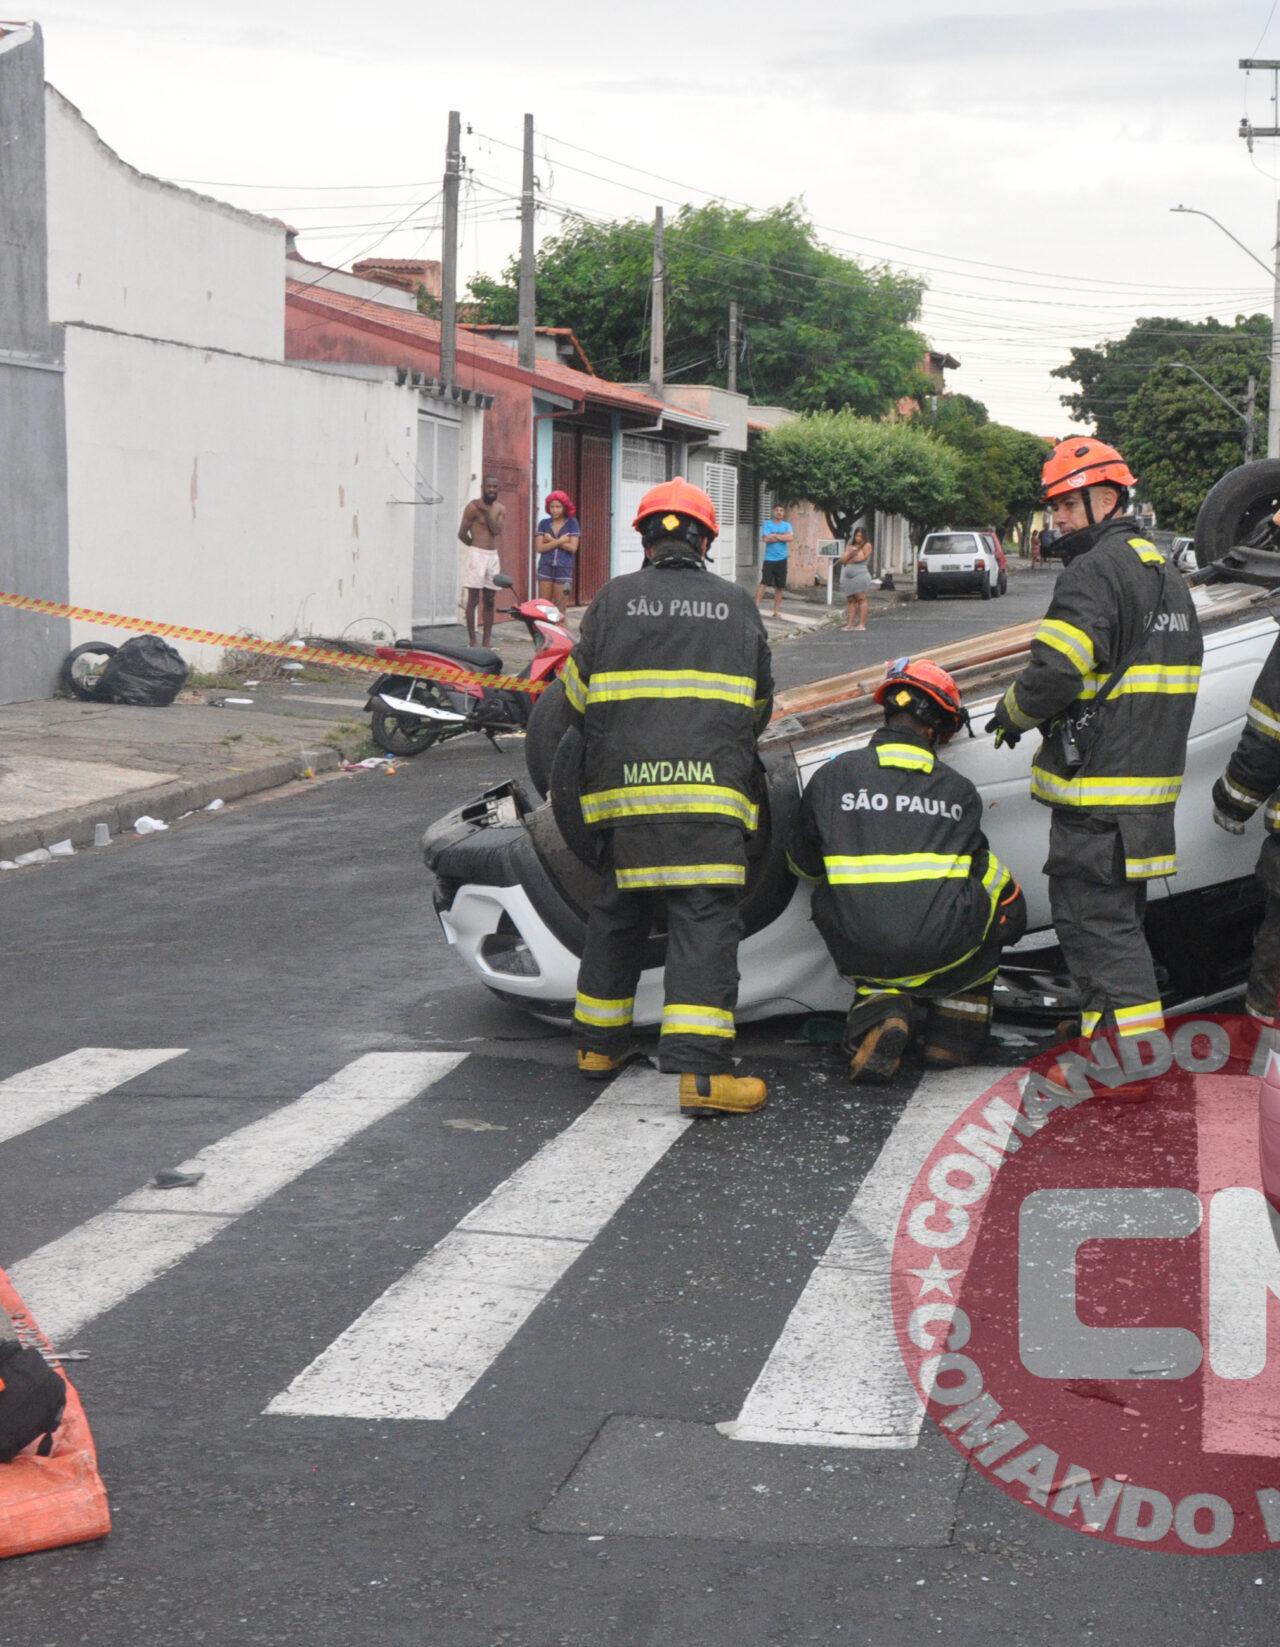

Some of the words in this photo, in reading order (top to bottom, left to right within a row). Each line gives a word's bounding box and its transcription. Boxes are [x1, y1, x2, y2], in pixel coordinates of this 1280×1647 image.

[626, 595, 664, 616] SÃO
[669, 599, 730, 621] PAULO
[623, 760, 716, 785] MAYDANA
[840, 788, 889, 812] SÃO
[895, 794, 963, 822] PAULO
